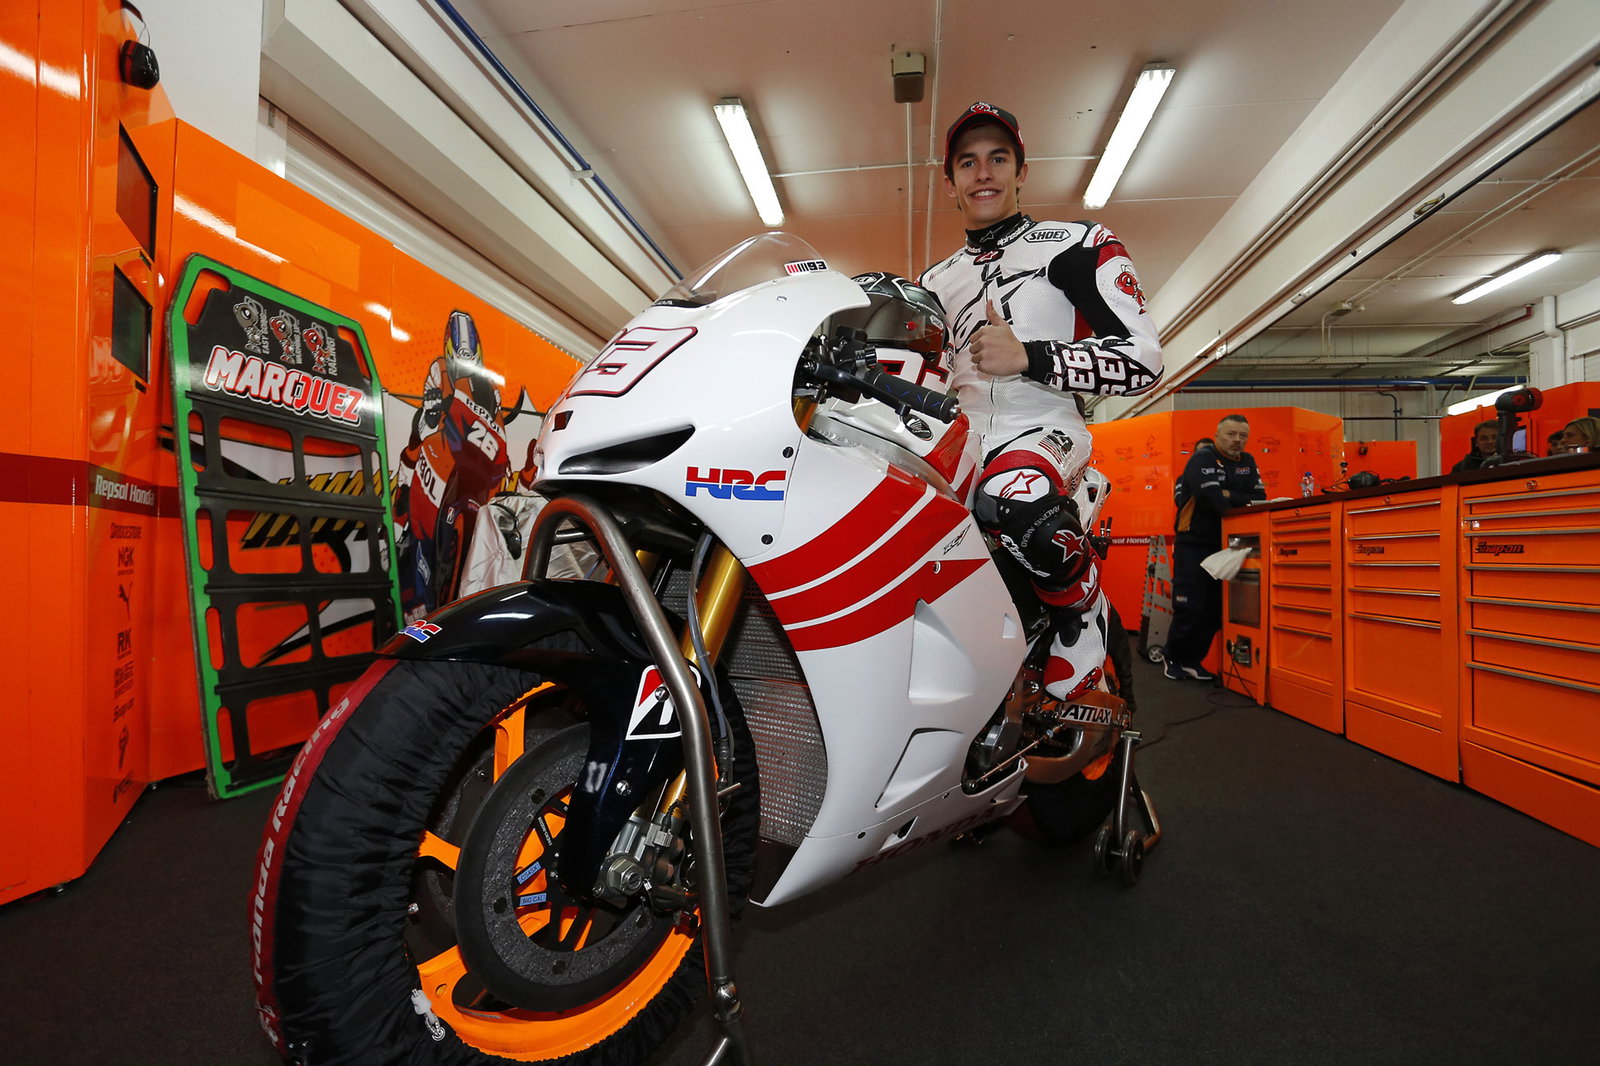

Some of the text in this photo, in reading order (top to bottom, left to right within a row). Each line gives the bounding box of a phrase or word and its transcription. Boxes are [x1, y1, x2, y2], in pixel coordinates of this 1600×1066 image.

[1029, 230, 1065, 241] SHOEI
[260, 333, 270, 355] EASY
[203, 345, 366, 425] MARQUEZ
[466, 420, 500, 461] 26
[95, 474, 156, 506] Repsol Honda
[685, 466, 787, 501] HRC
[118, 546, 134, 568] NGK
[118, 628, 132, 654] RK
[1060, 703, 1111, 724] ATTLAX
[271, 696, 350, 833] Racing
